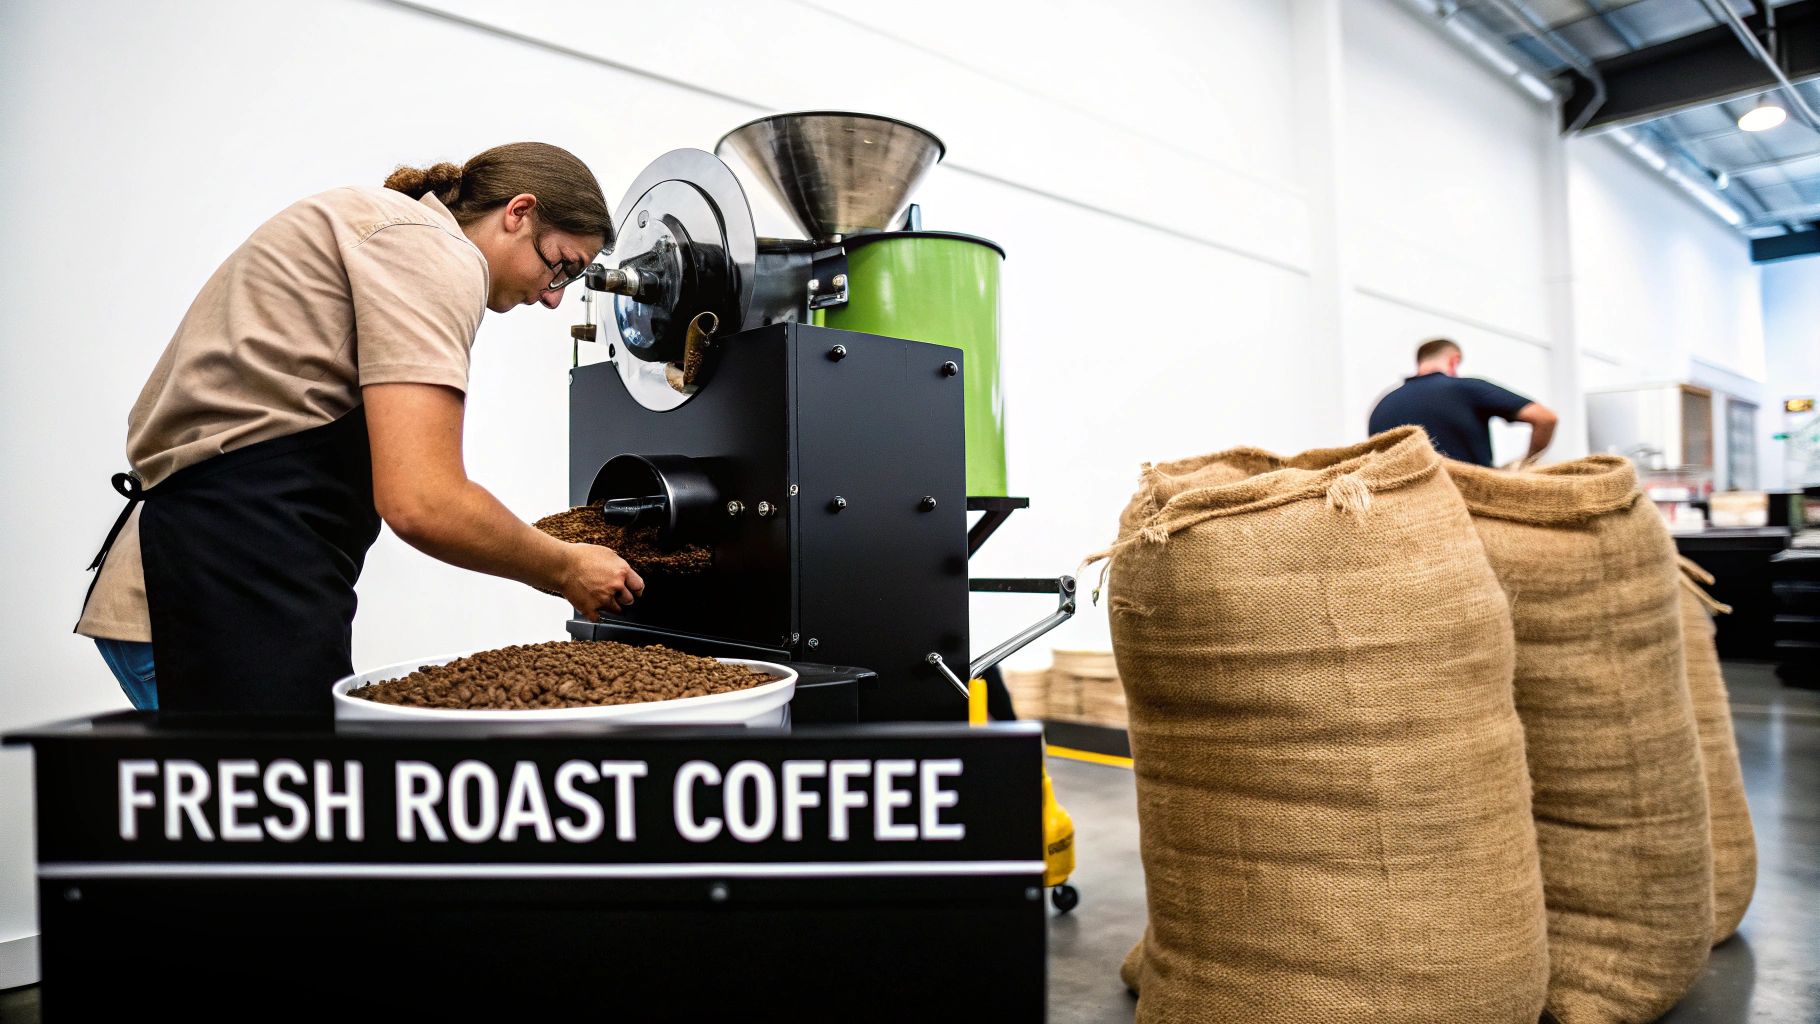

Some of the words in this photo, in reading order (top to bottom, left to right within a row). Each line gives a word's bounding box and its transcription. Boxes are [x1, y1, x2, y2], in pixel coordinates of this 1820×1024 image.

[119, 760, 364, 841] FRESH
[395, 760, 647, 842] ROAST
[674, 758, 966, 842] COFFEE
